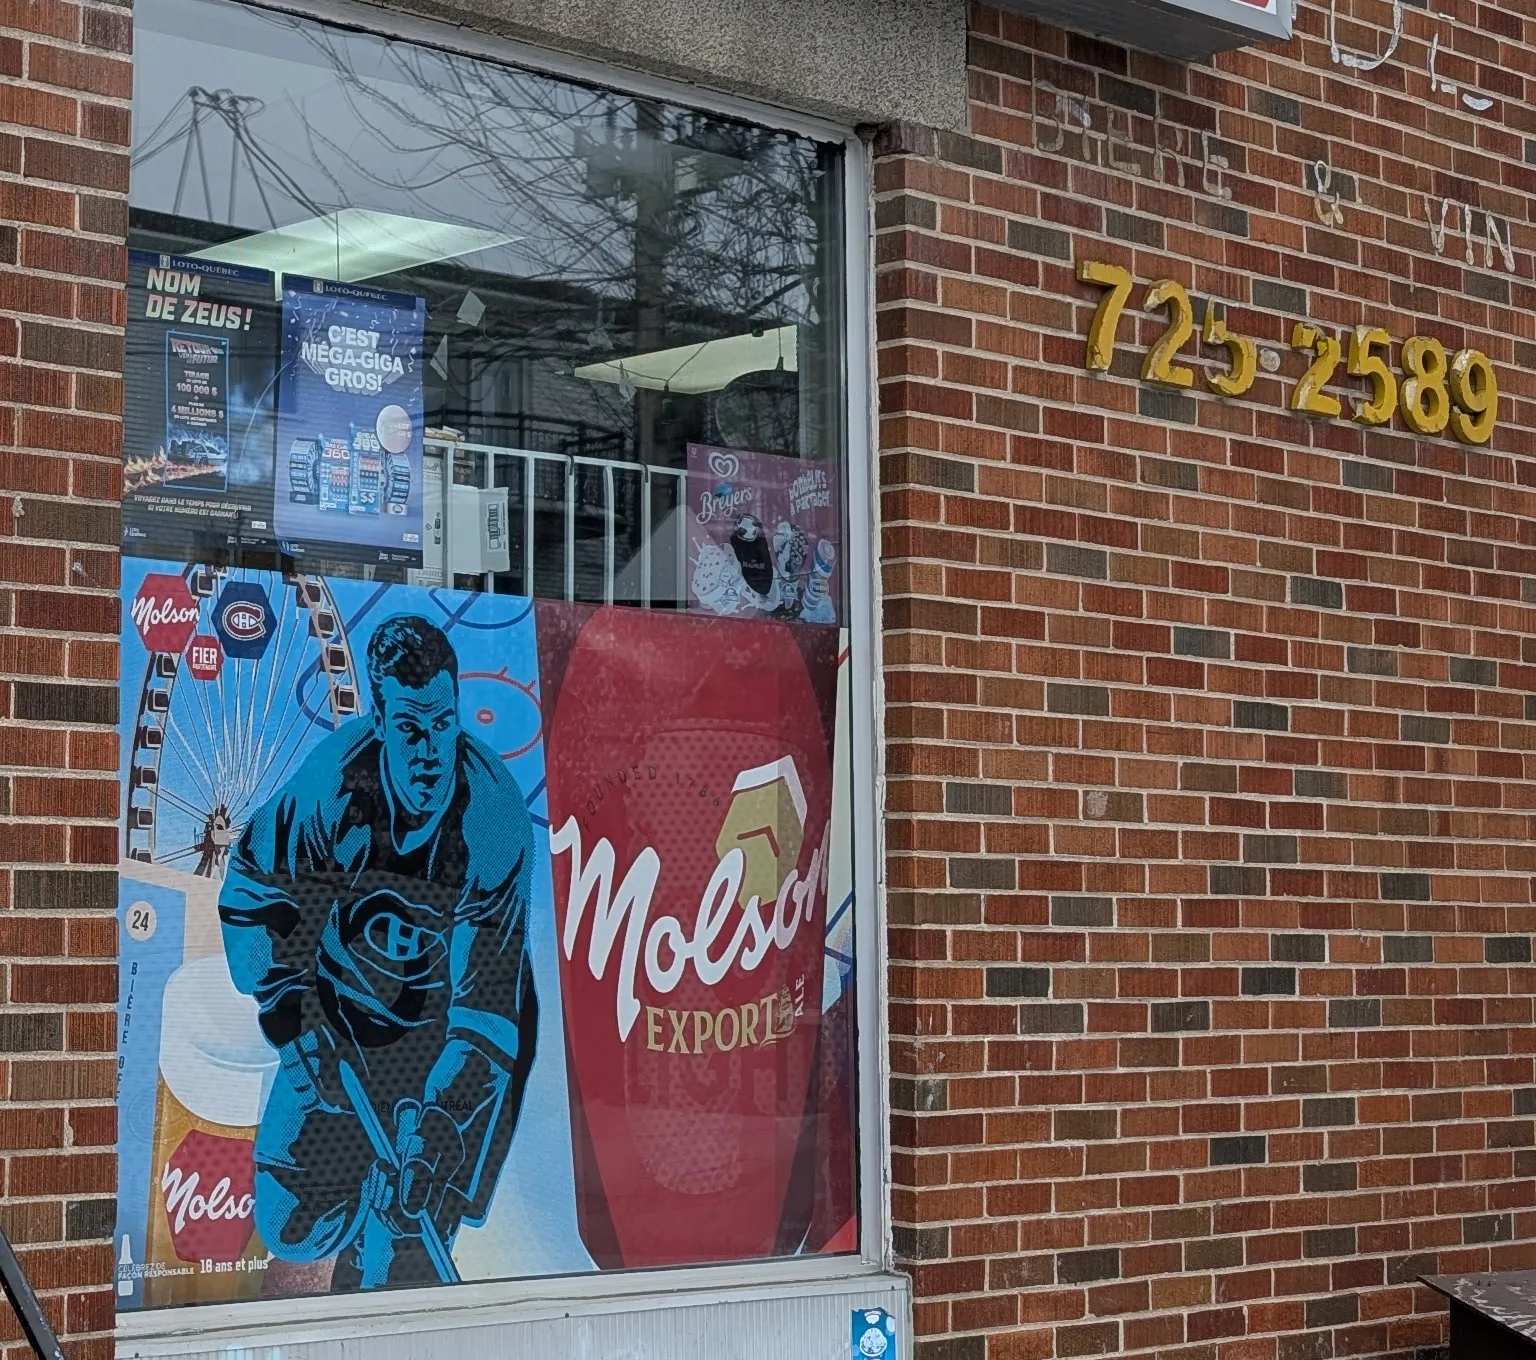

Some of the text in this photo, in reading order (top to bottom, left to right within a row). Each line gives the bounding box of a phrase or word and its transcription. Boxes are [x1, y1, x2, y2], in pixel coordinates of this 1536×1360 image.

[1424, 197, 1514, 272] VIN
[147, 268, 201, 297] NOM
[145, 294, 253, 331] DE ZEUS!
[328, 325, 380, 349] C'EST
[301, 340, 404, 375] MÉGA-GIGA
[325, 367, 382, 392] GROS!
[696, 487, 754, 524] Breyers
[131, 596, 200, 635] Molson
[192, 646, 217, 664] FIER
[582, 766, 657, 834] FOUNDED
[131, 910, 150, 931] 24
[549, 815, 830, 1043] Molson
[795, 974, 804, 1017] ALE
[646, 992, 784, 1054] EXPORT
[162, 1162, 256, 1234] Molso
[200, 1256, 268, 1274] 18 ans et plus
